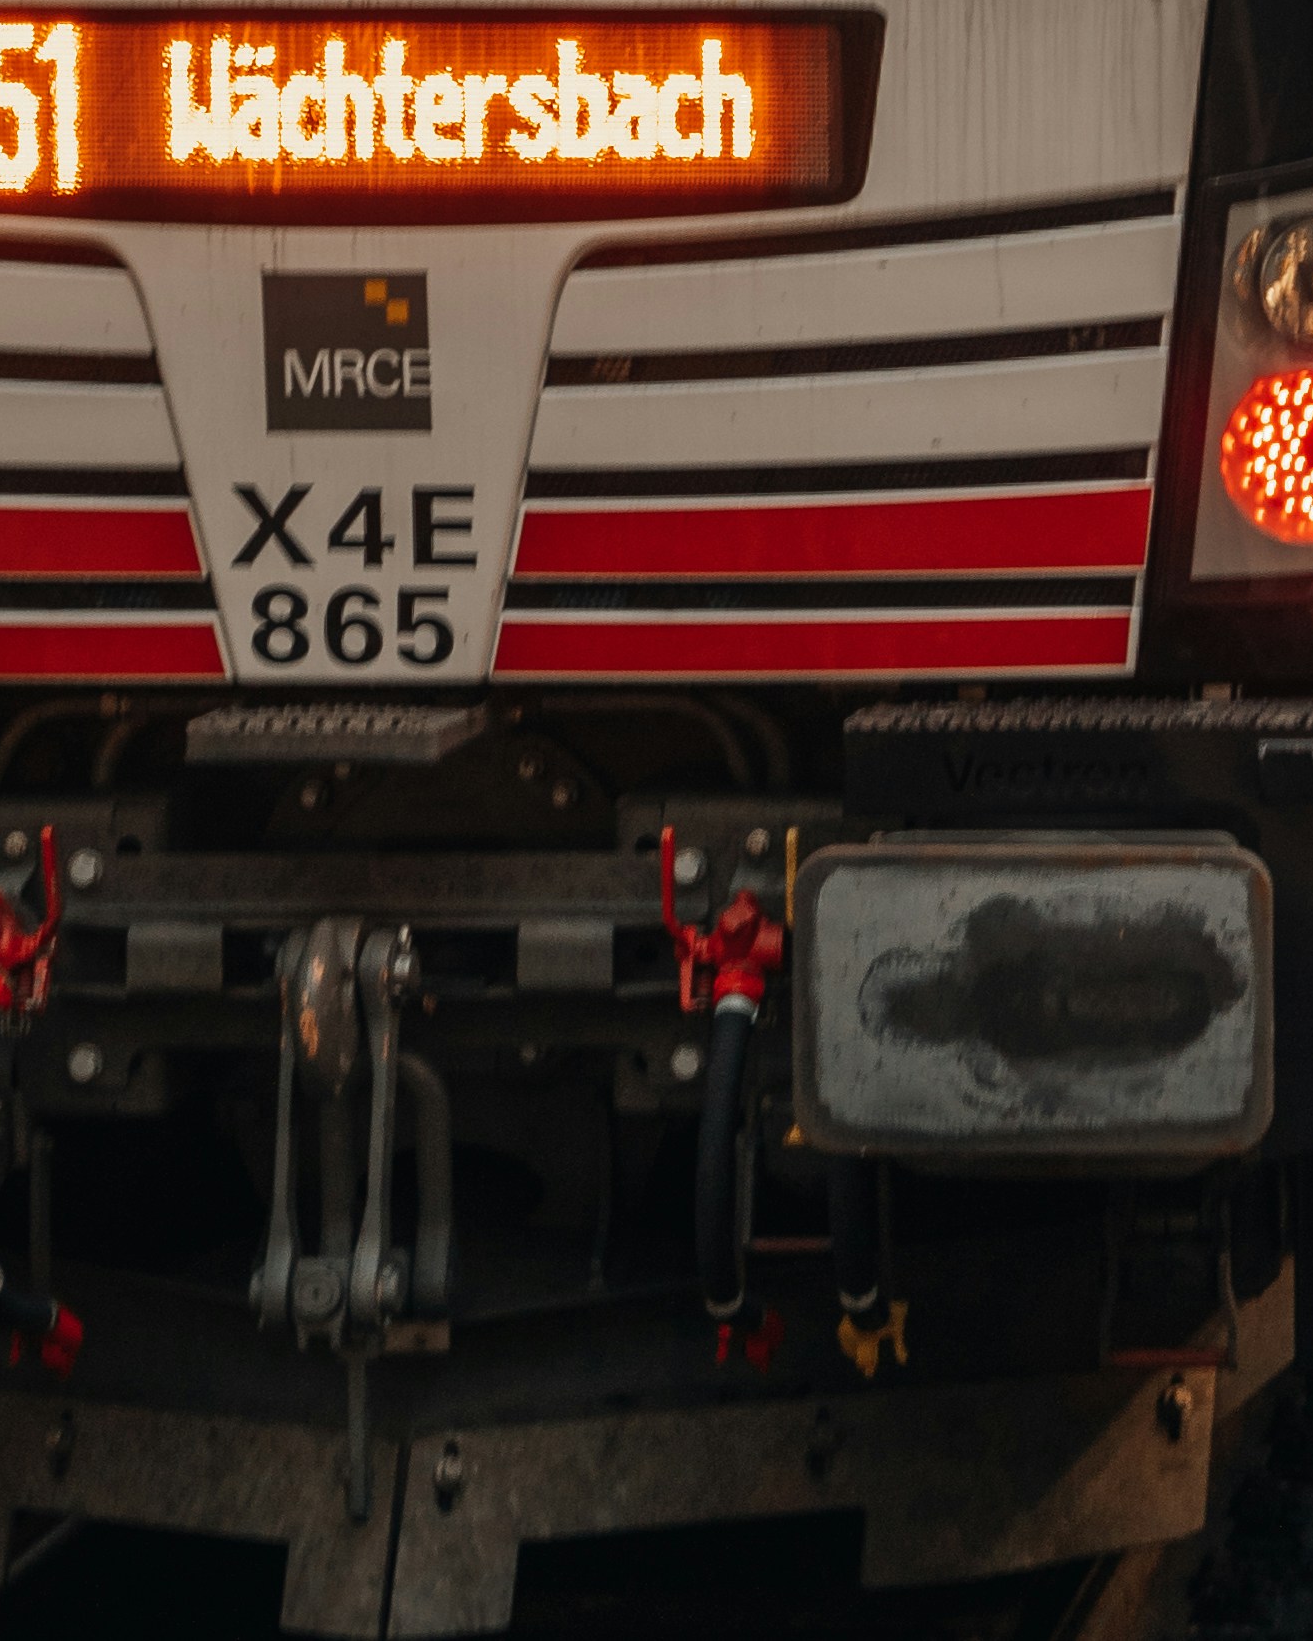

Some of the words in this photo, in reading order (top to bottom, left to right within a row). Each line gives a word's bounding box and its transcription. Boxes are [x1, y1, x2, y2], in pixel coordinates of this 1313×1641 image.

[163, 32, 756, 166] Wächtersbach
[283, 347, 432, 399] MRCE
[231, 480, 479, 572] X4E
[250, 580, 455, 670] 865
